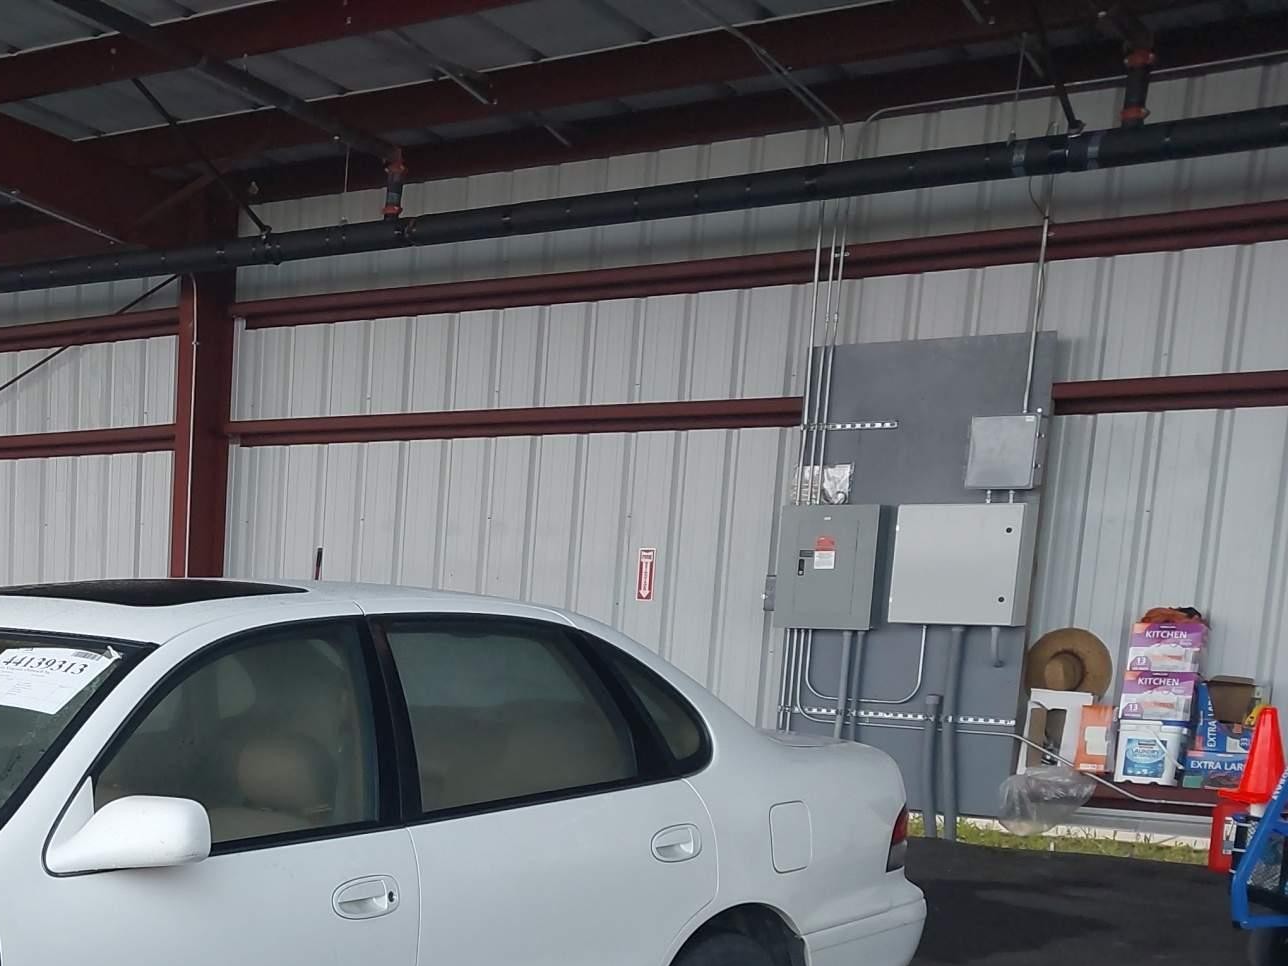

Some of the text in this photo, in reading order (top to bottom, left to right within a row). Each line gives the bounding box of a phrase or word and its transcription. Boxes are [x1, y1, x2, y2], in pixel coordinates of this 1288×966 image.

[1145, 630, 1187, 639] KITCHEN
[2, 655, 89, 675] 44139313
[1136, 657, 1147, 666] 13
[1137, 677, 1180, 686] KITCHEN
[1128, 703, 1139, 711] 13
[1207, 719, 1217, 748] EXTRA
[1190, 760, 1245, 771] EXTRA LAR
